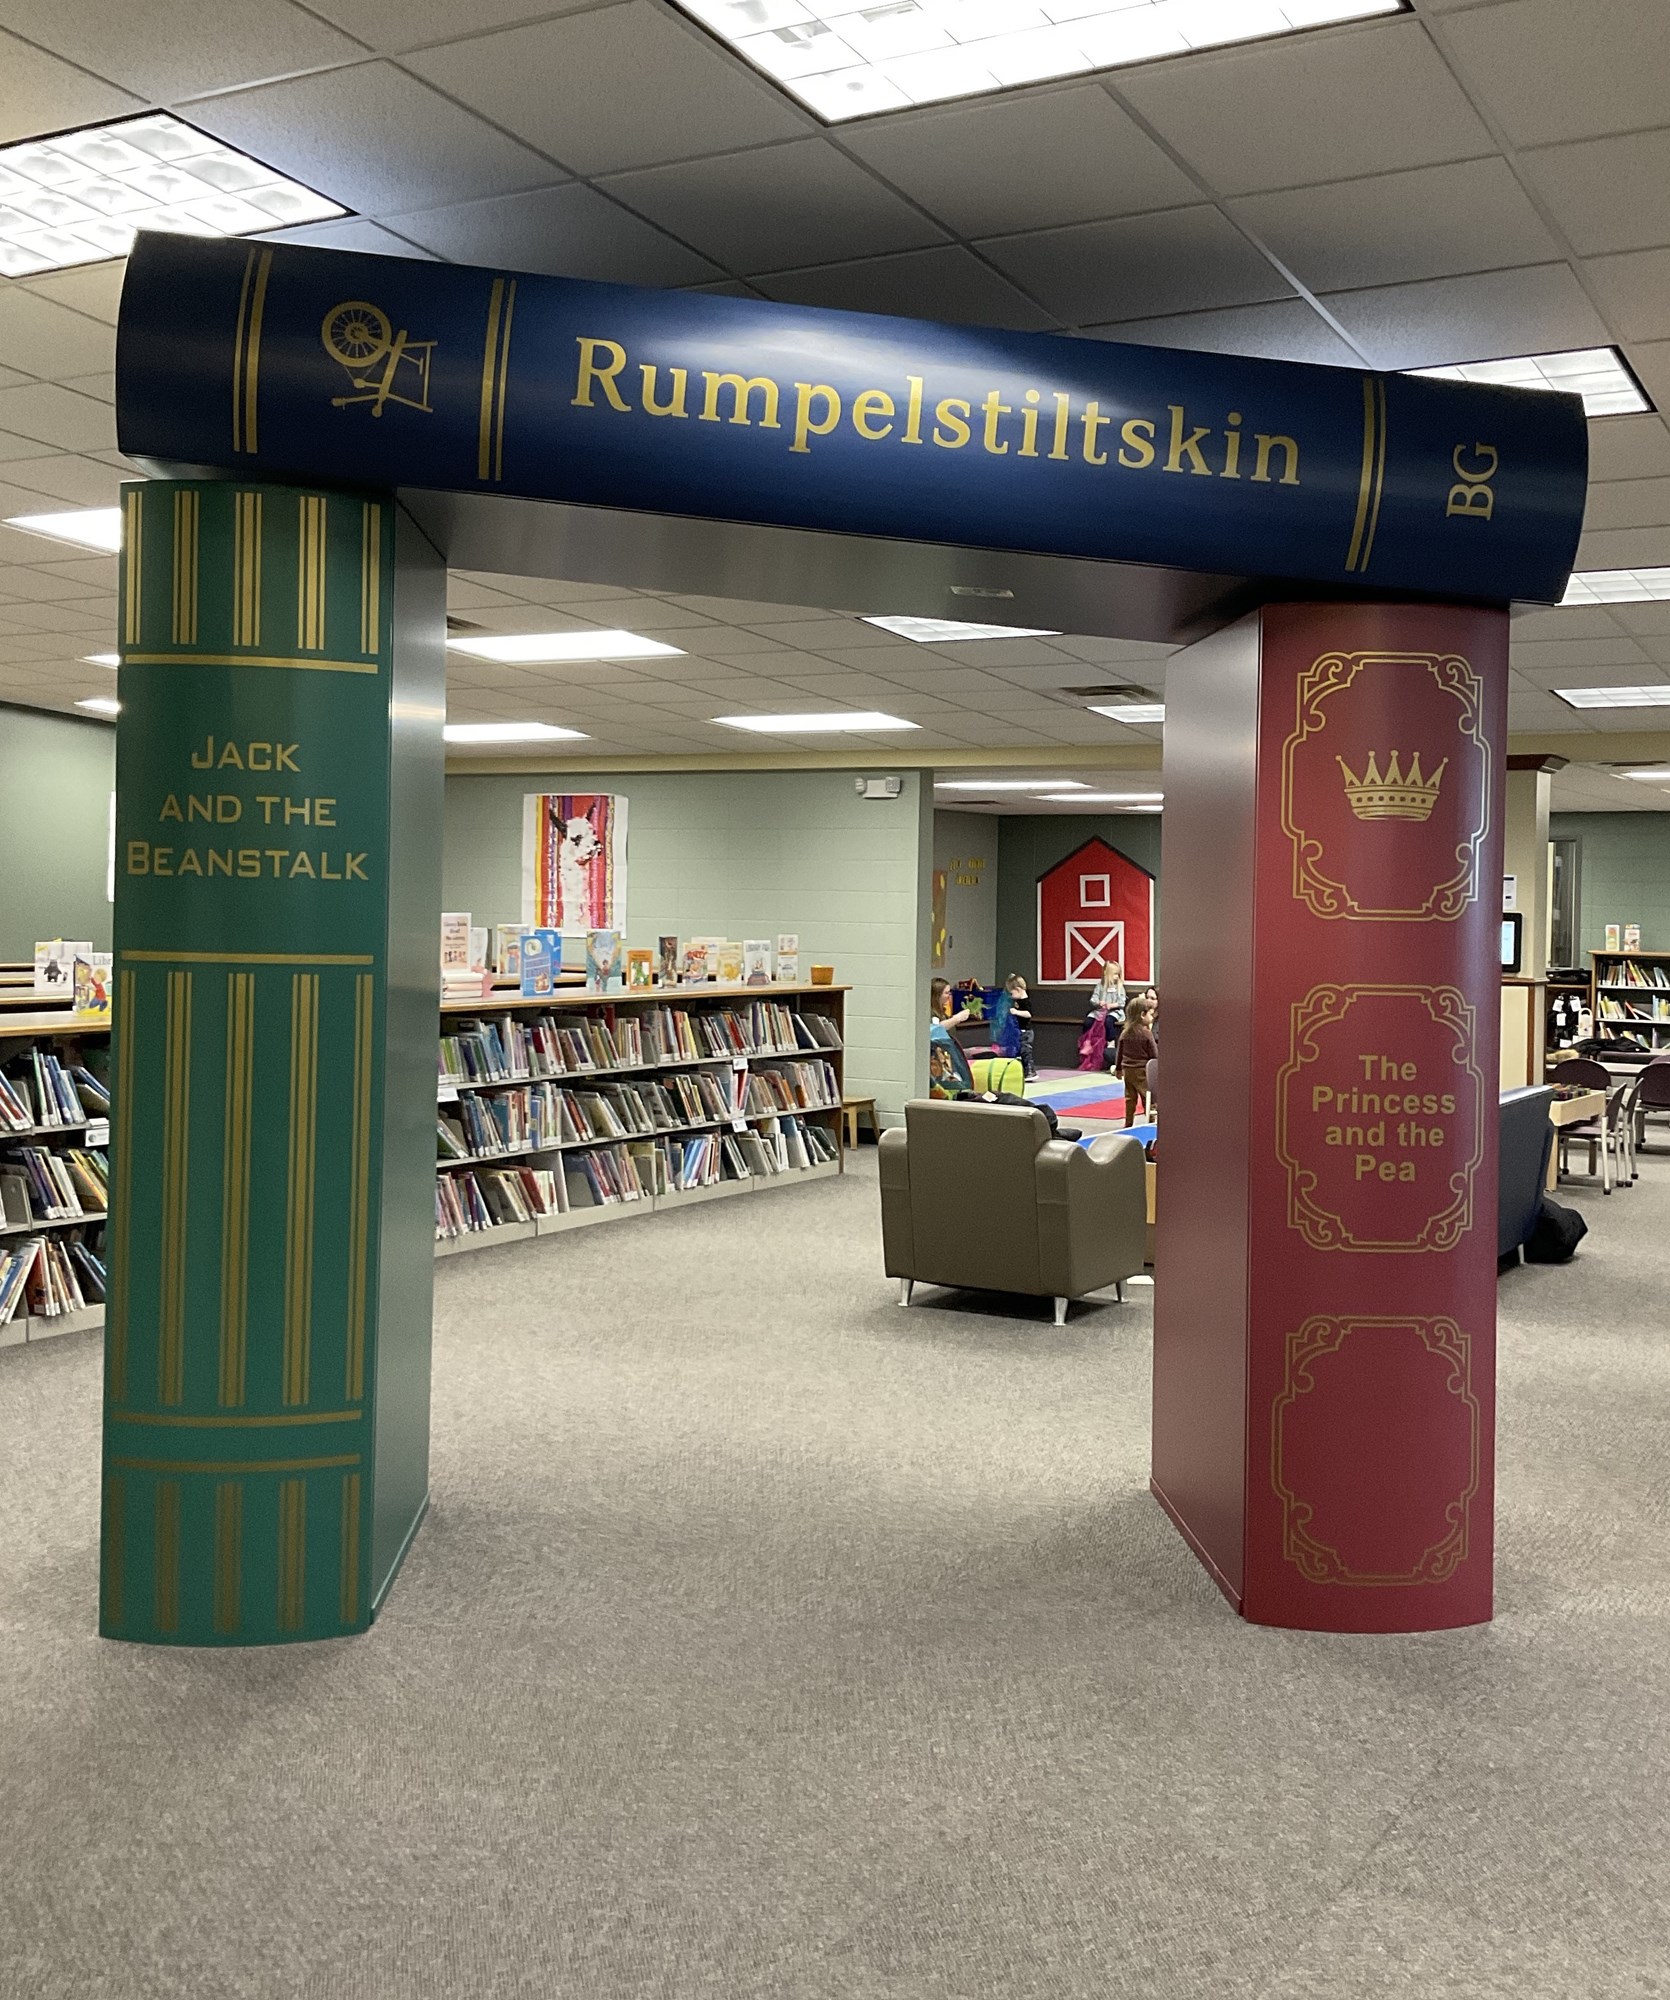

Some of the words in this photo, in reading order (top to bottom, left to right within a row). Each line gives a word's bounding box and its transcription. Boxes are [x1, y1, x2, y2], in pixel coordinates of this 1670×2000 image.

[571, 336, 1302, 486] Rumpelstiltskin
[1446, 441, 1499, 521] BG
[191, 735, 301, 772] JACK
[159, 794, 243, 823] AND
[256, 796, 337, 827] THE
[127, 841, 369, 881] BEANSTALK
[1358, 1054, 1418, 1082] The
[1312, 1085, 1456, 1115] Princess
[1325, 1121, 1386, 1147] and
[1397, 1121, 1445, 1147] the
[1355, 1154, 1416, 1182] Pea
